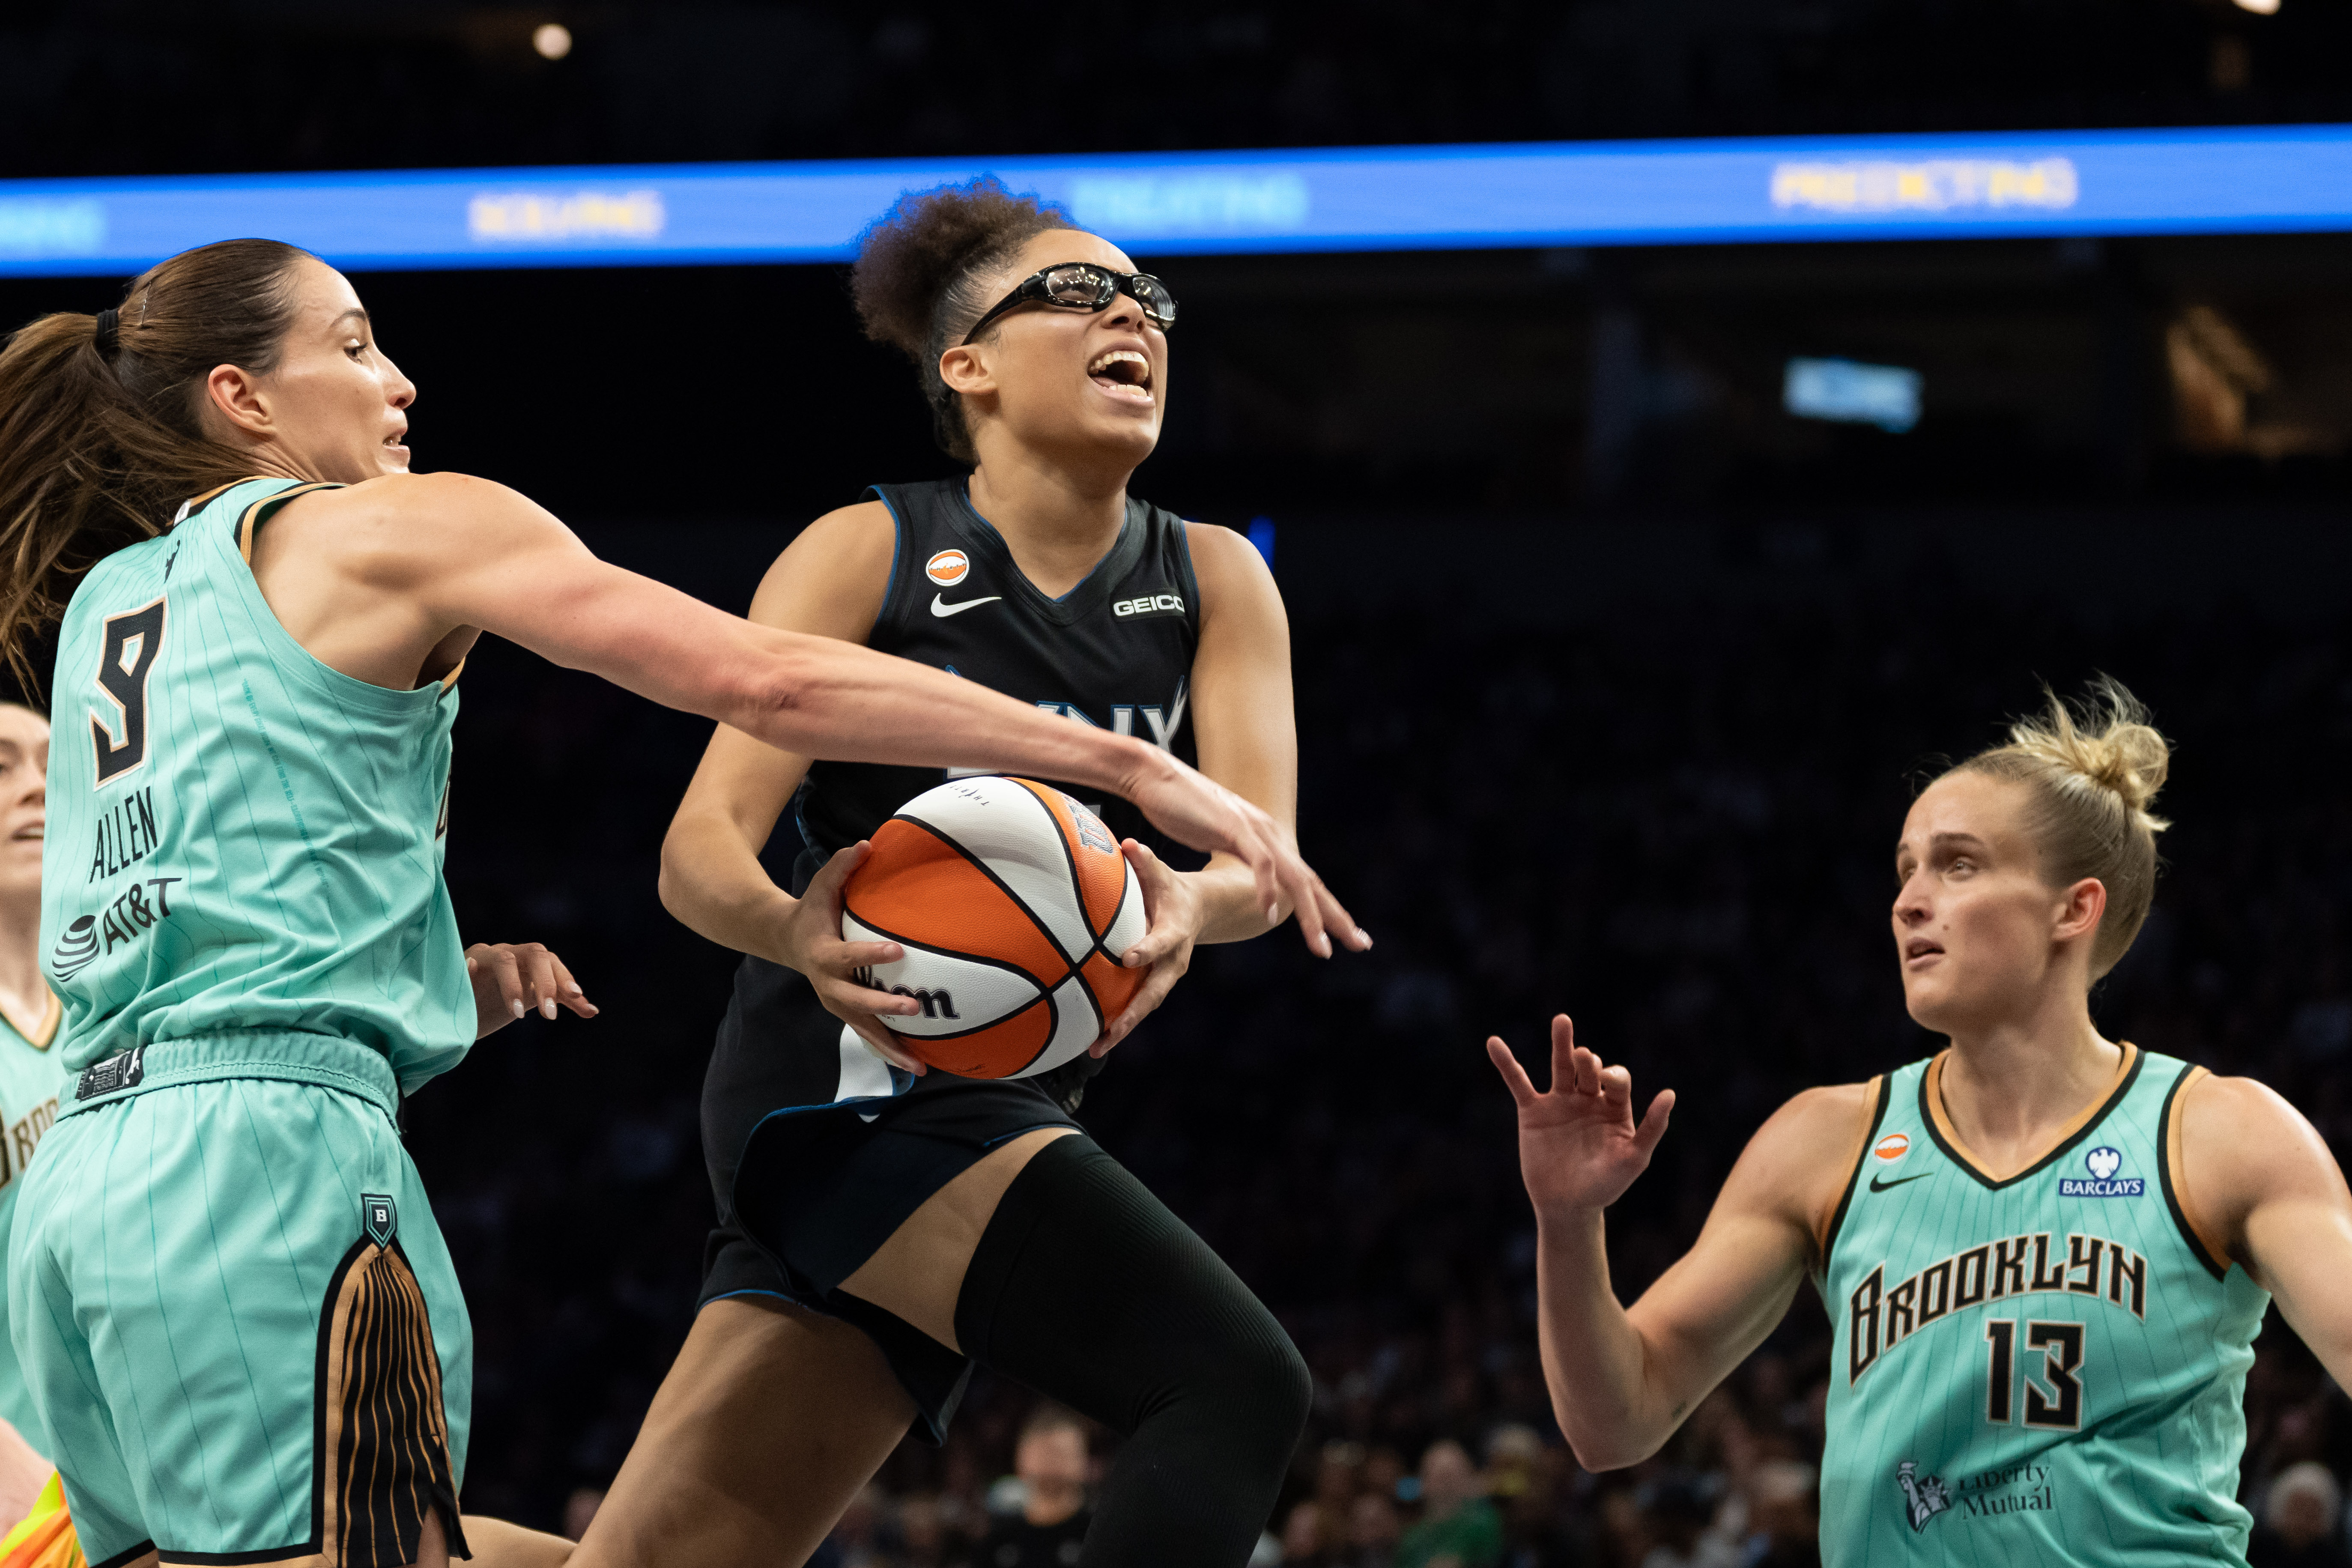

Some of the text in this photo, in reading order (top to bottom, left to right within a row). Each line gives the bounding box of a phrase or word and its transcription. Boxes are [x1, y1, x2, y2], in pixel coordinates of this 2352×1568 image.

[1113, 594, 1185, 616] GEICO
[89, 593, 167, 791] 9
[89, 786, 158, 884] ALLEN
[102, 878, 182, 956] AT&T
[2063, 1180, 2141, 1196] BARCLAYS
[375, 1209, 387, 1222] B
[1985, 1318, 2086, 1431] 13
[1963, 1488, 2052, 1519] Mutual
